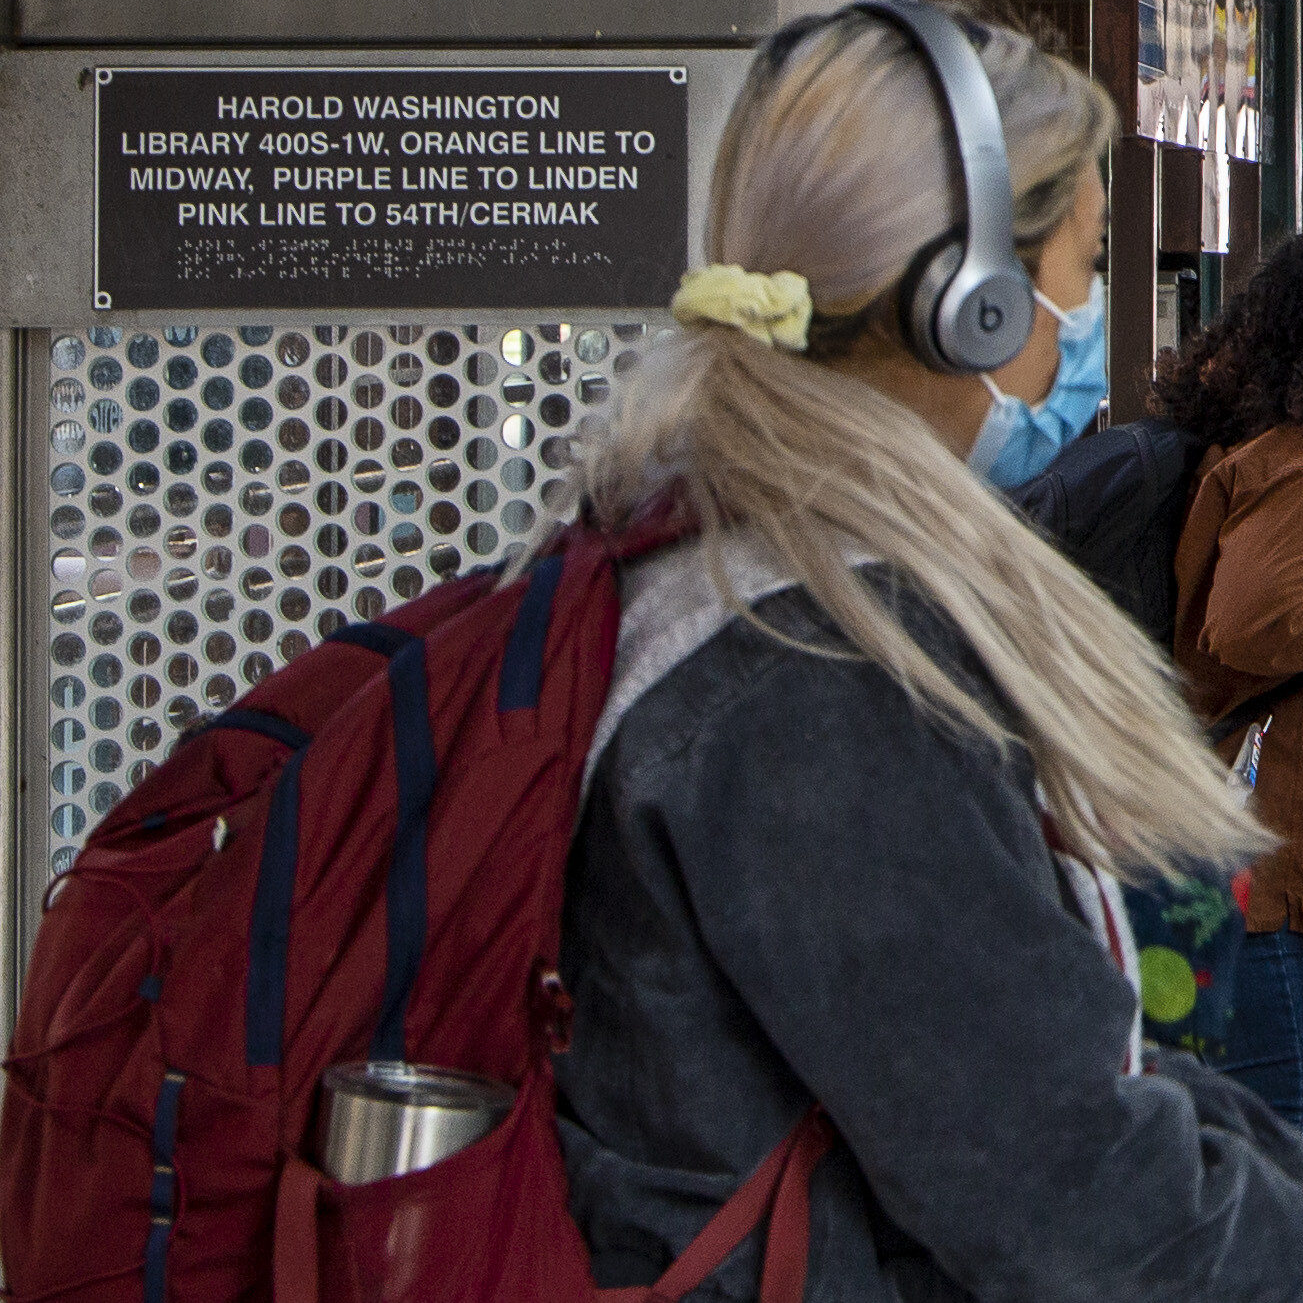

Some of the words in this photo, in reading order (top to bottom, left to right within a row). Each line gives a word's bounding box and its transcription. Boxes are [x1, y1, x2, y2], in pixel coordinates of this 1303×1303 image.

[219, 96, 343, 119] HAROLD
[354, 96, 559, 119] WASHINGTON
[122, 132, 249, 154] LIBRARY
[401, 131, 529, 154] ORANGE
[540, 132, 605, 154] LINE
[615, 131, 655, 154] TO
[131, 168, 253, 193] MIDWAY,
[274, 167, 391, 190] PURPLE
[403, 167, 468, 189] LINE
[477, 167, 518, 189] TO
[529, 167, 637, 189] LINDEN
[179, 203, 249, 225] PINK
[261, 203, 326, 225] LINE
[336, 203, 376, 225] TO
[386, 202, 599, 226] 54TH/CERMAK
